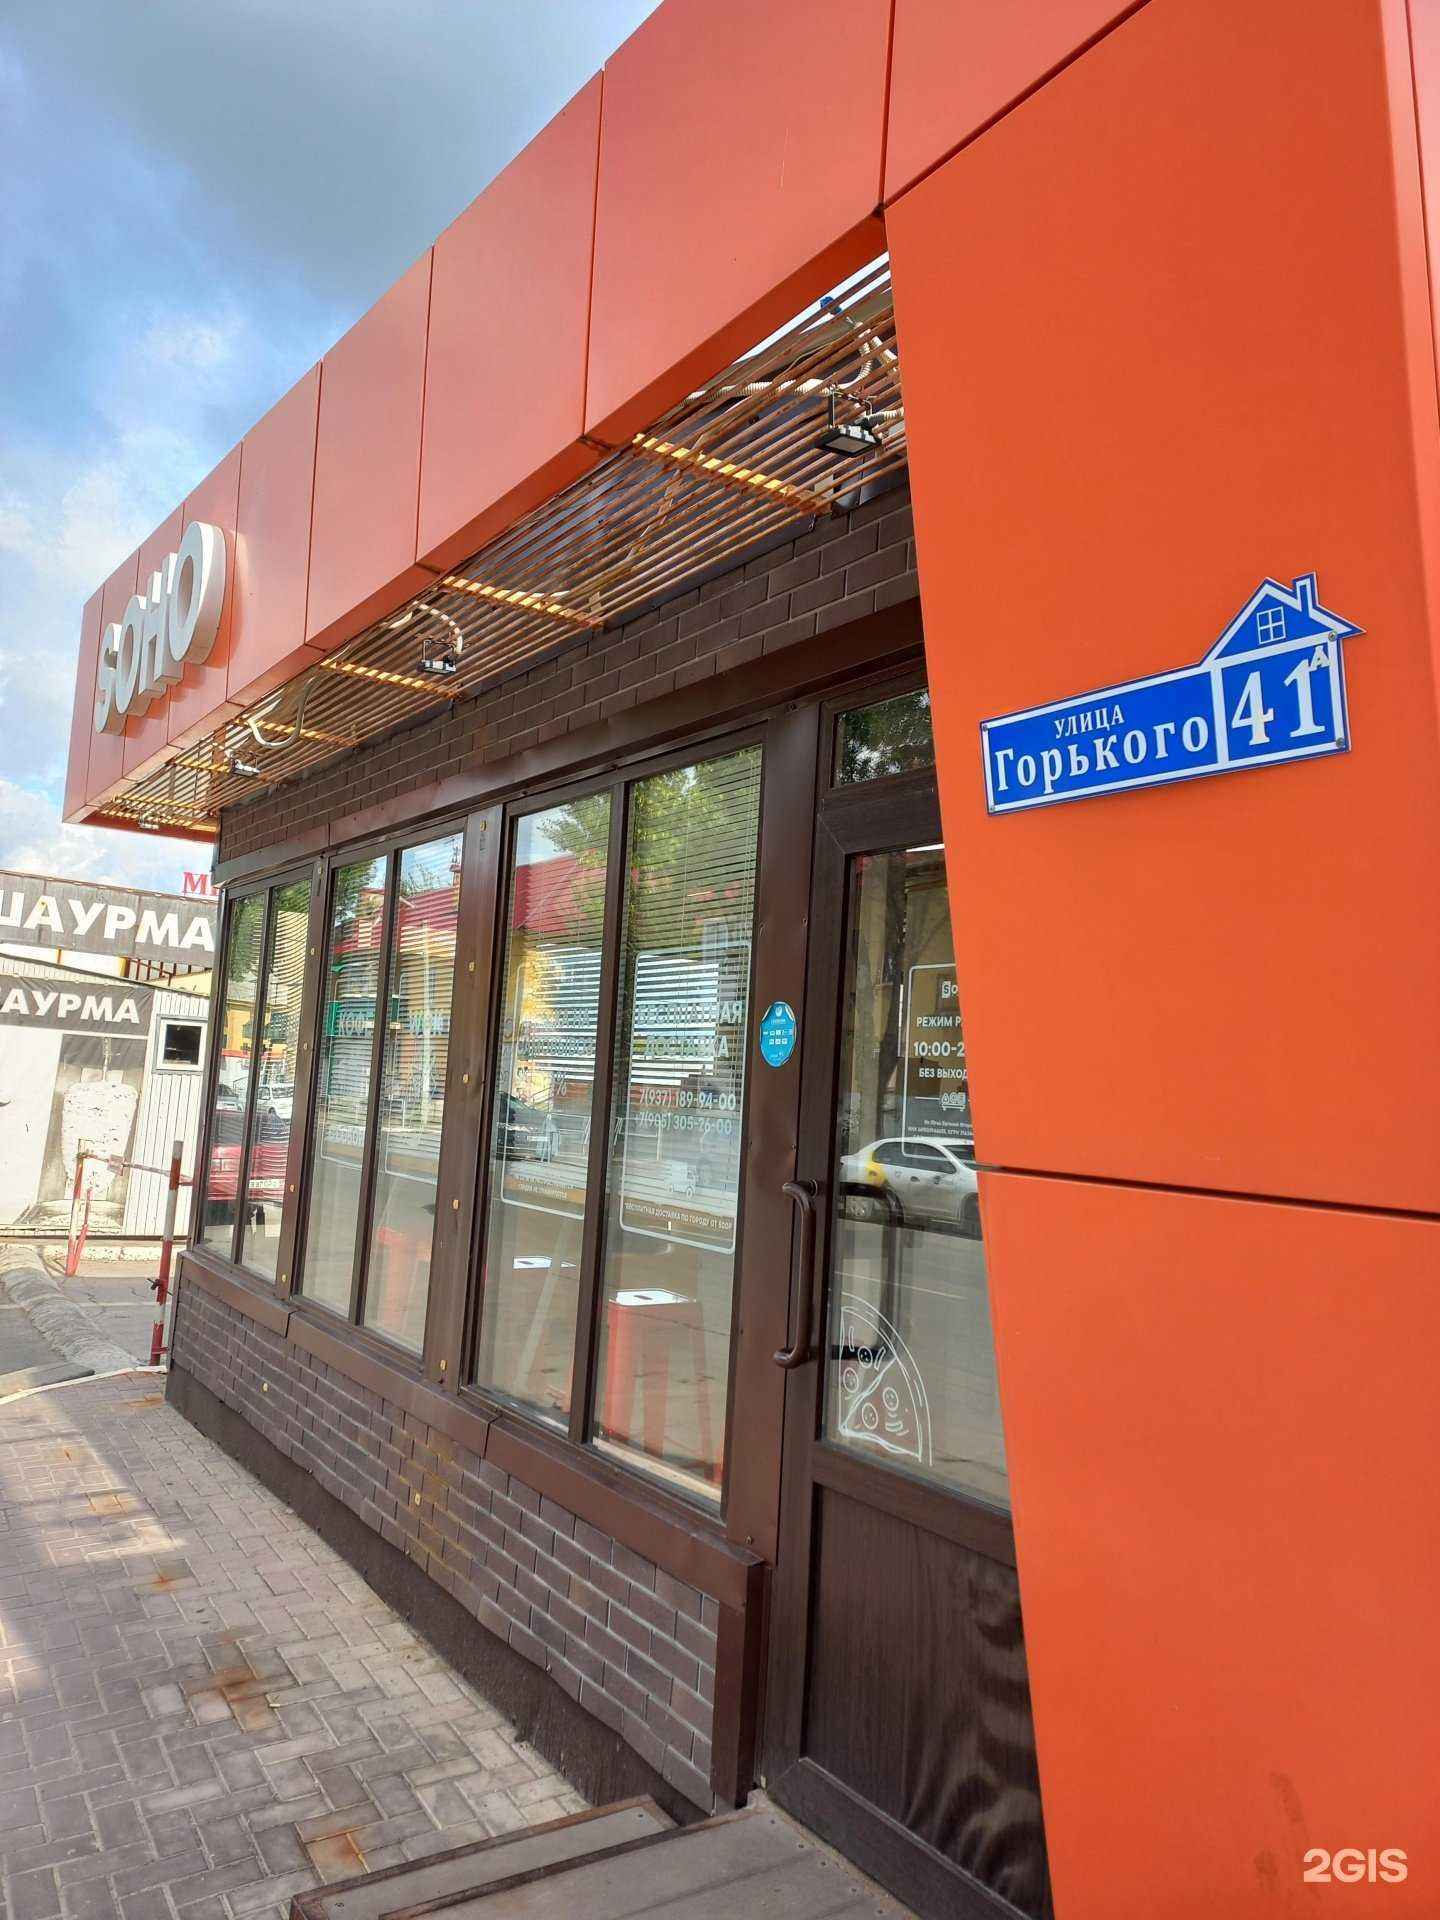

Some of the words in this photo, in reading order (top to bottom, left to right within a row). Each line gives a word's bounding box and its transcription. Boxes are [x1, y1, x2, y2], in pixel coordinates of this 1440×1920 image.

[1055, 704, 1125, 739] УЛИЦА
[994, 715, 1209, 794] Горького
[0, 987, 141, 1024] АУРМА
[916, 1015, 953, 1028] РЕЖИМ
[913, 1040, 966, 1057] 10:00-2
[919, 1067, 935, 1079] БЕЗ
[936, 1068, 968, 1081] ВЫХОД
